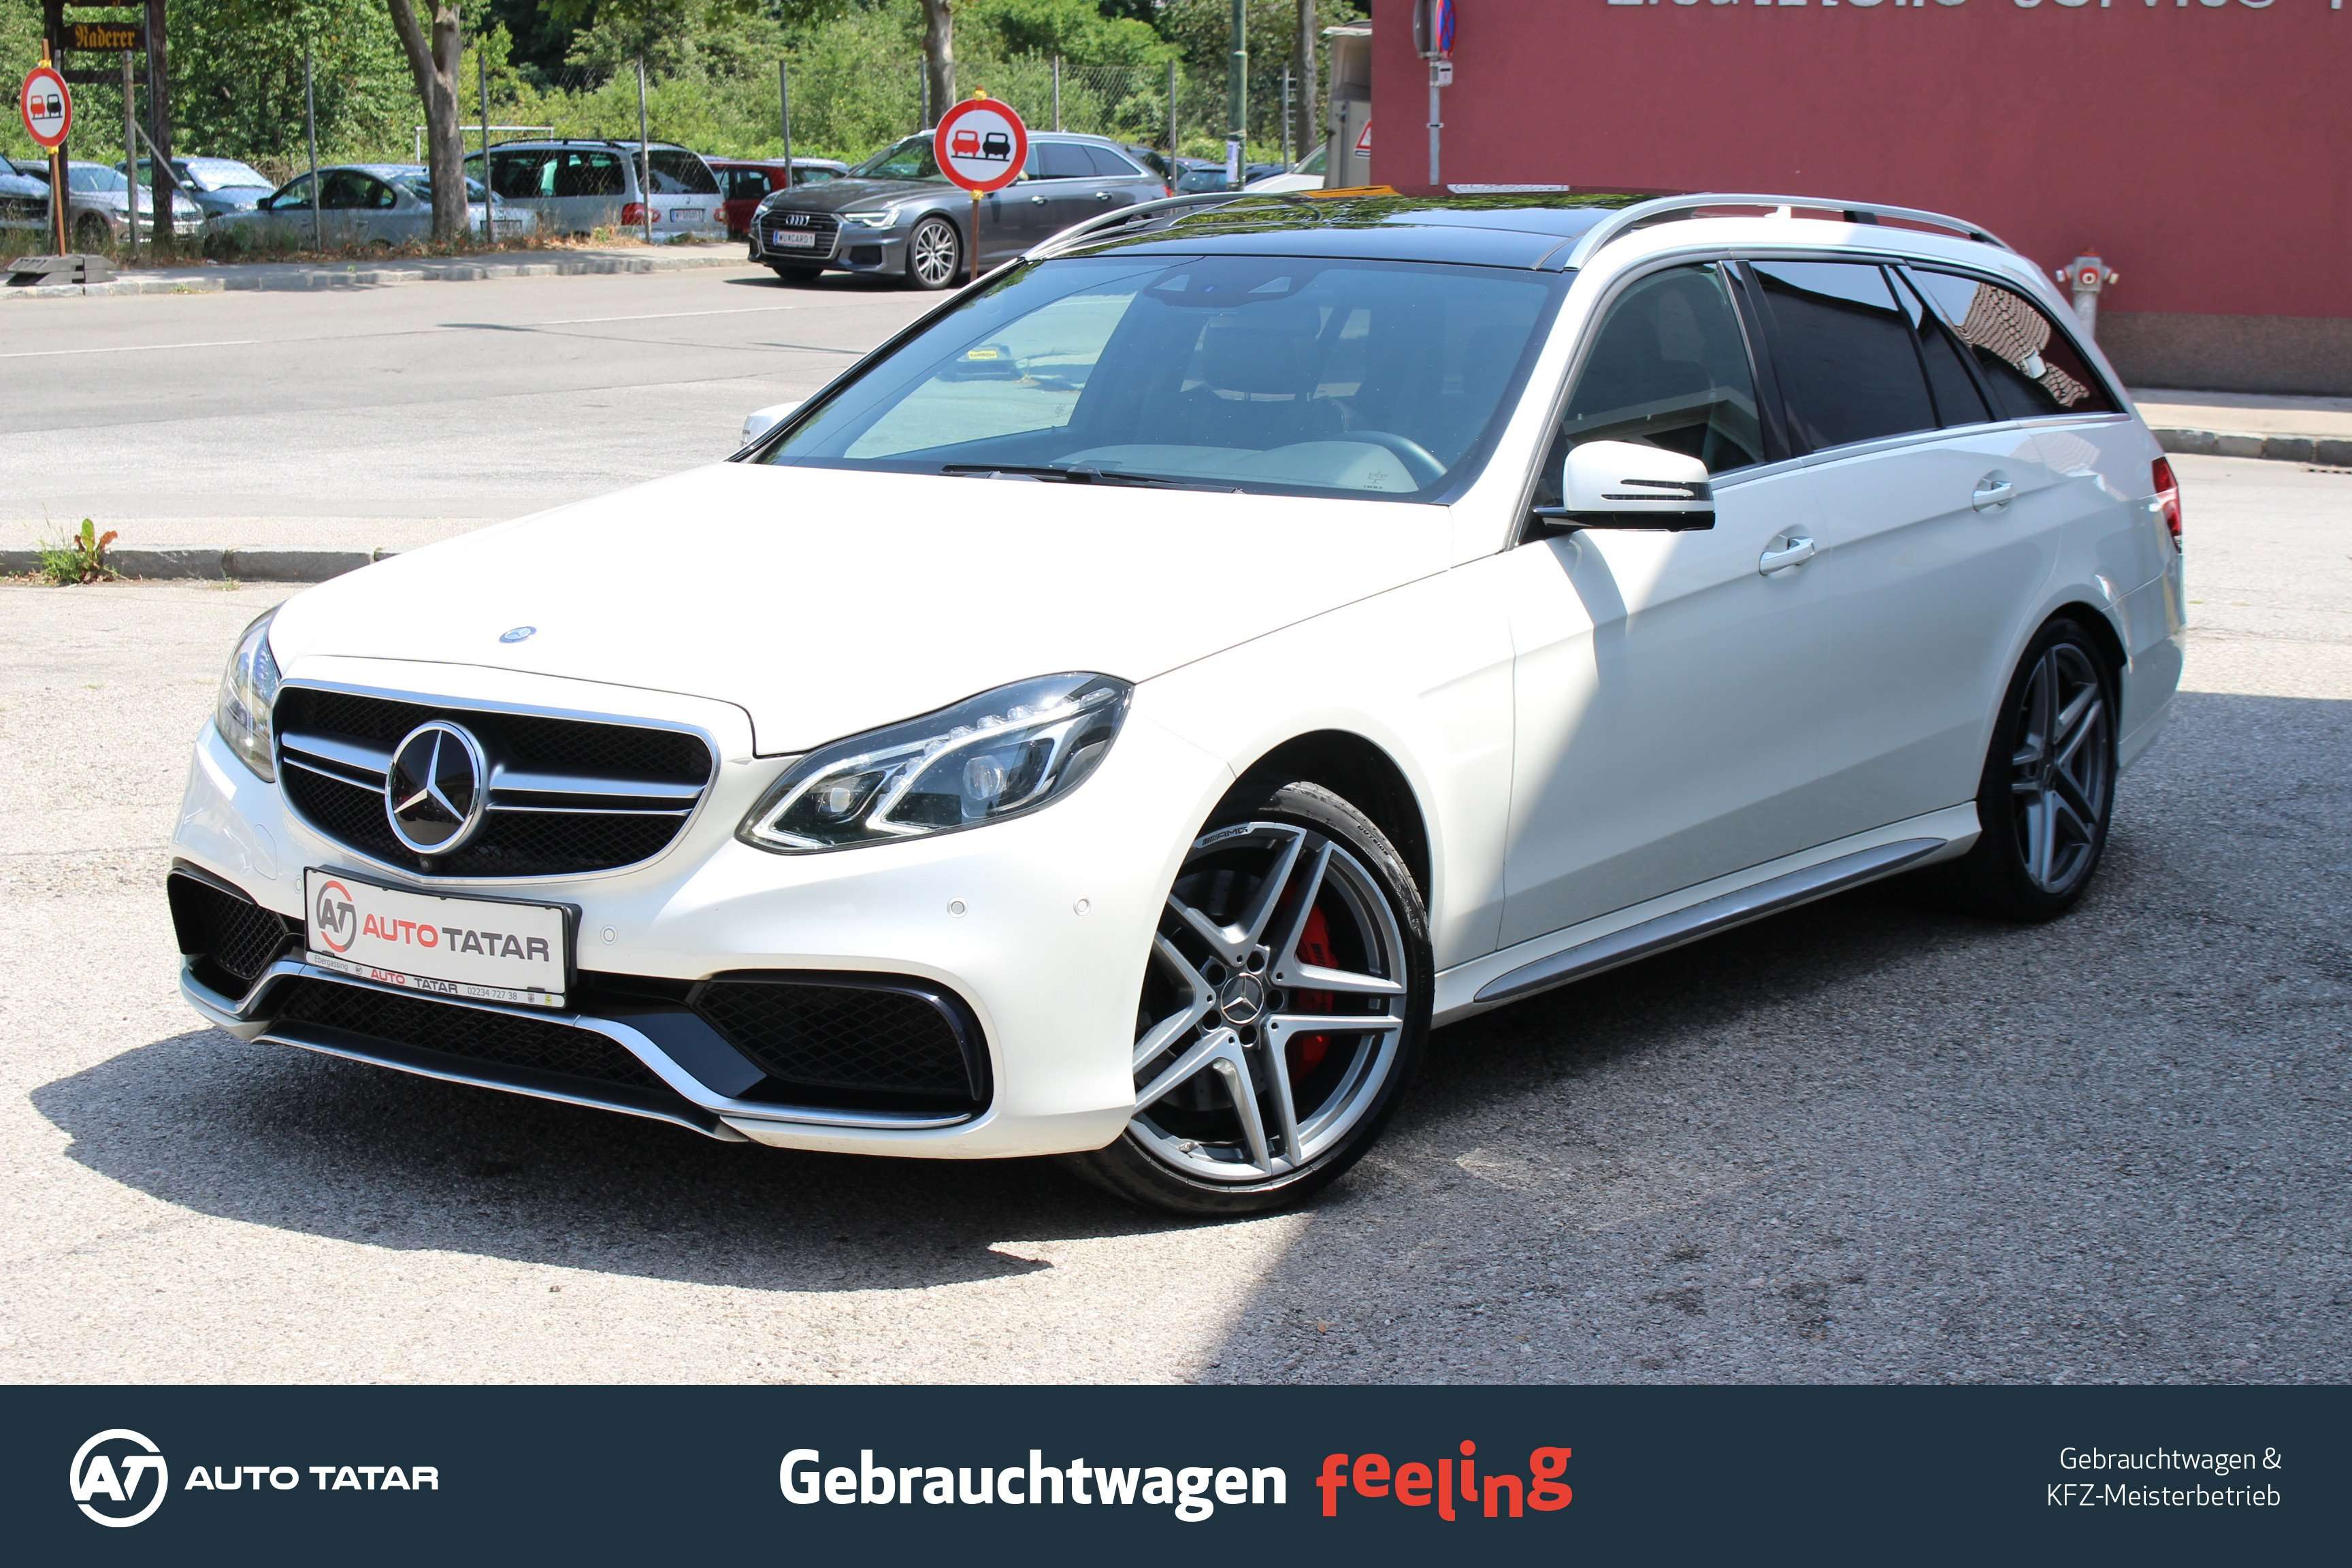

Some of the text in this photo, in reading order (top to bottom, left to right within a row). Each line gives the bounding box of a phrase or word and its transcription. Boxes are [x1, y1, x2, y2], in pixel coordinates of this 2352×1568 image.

[1216, 826, 1248, 839] AMG
[1357, 825, 1389, 855] OUTSIDE
[363, 913, 439, 948] AUTO
[442, 927, 549, 962] TATAR
[314, 955, 348, 972] Ebergassing
[371, 969, 406, 984] AUTO
[414, 977, 458, 994] TATAR
[467, 986, 489, 997] 02234
[493, 990, 506, 999] 727
[508, 992, 517, 1000] 38
